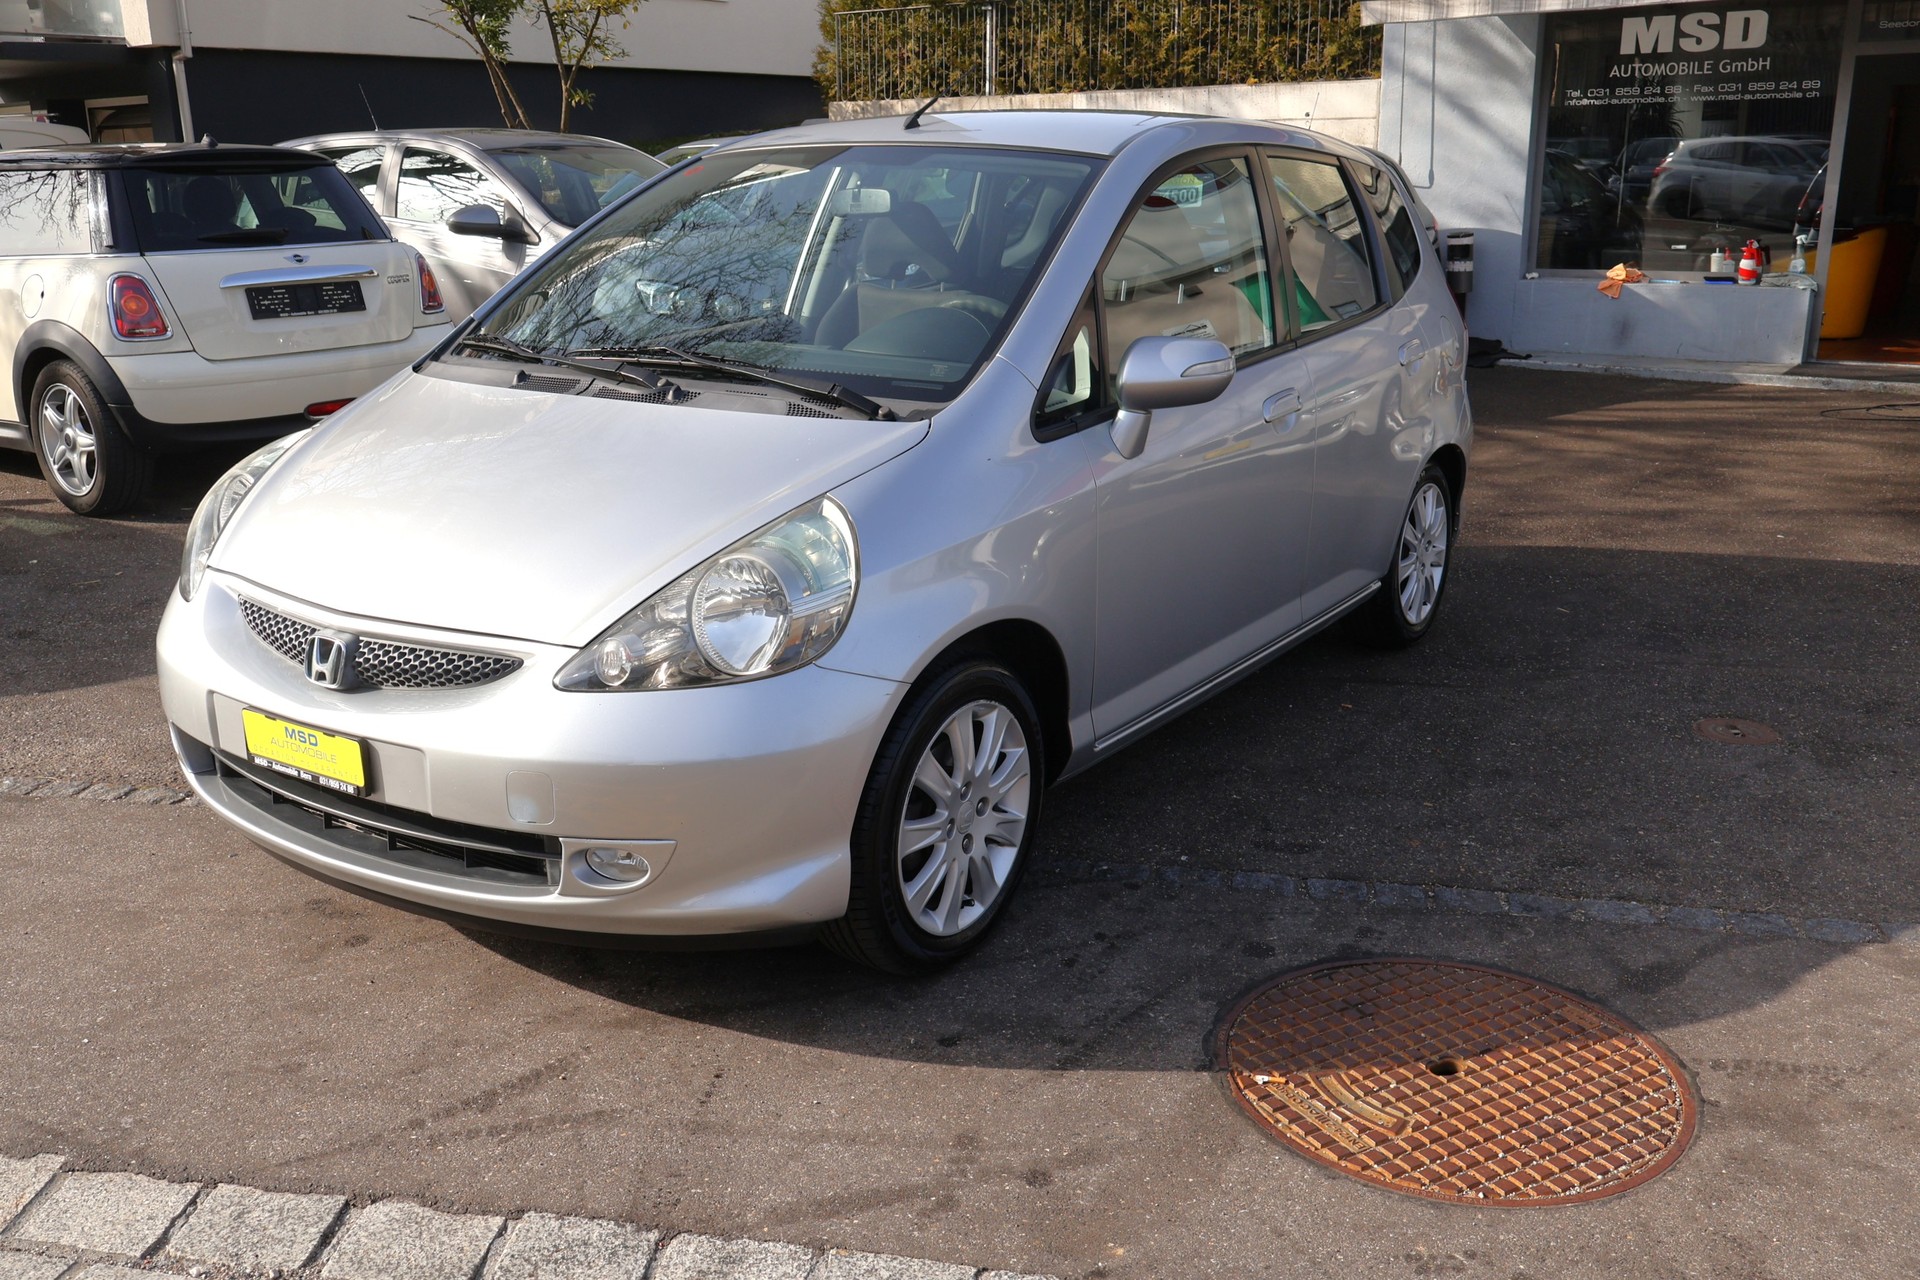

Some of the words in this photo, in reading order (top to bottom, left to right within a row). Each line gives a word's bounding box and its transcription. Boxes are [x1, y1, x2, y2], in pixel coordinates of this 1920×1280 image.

[1620, 9, 1769, 55] MSD
[1609, 61, 1714, 78] AUTOMOBILE
[1719, 57, 1771, 74] GmbH
[1565, 89, 1583, 98] Tel.
[1587, 88, 1610, 97] 031
[1615, 86, 1640, 96] 859
[1644, 86, 1661, 95] 24
[1665, 85, 1682, 94] 88
[1693, 84, 1714, 93] Fax
[1718, 83, 1742, 92] 031
[1748, 82, 1775, 91] 859
[1779, 81, 1798, 90] 24
[1802, 80, 1821, 89] 89
[1564, 96, 1680, 106] info@msd-automobile.ch
[285, 726, 319, 747] MSD
[270, 737, 337, 764] AUTOMOBILE
[254, 756, 268, 767] MSD
